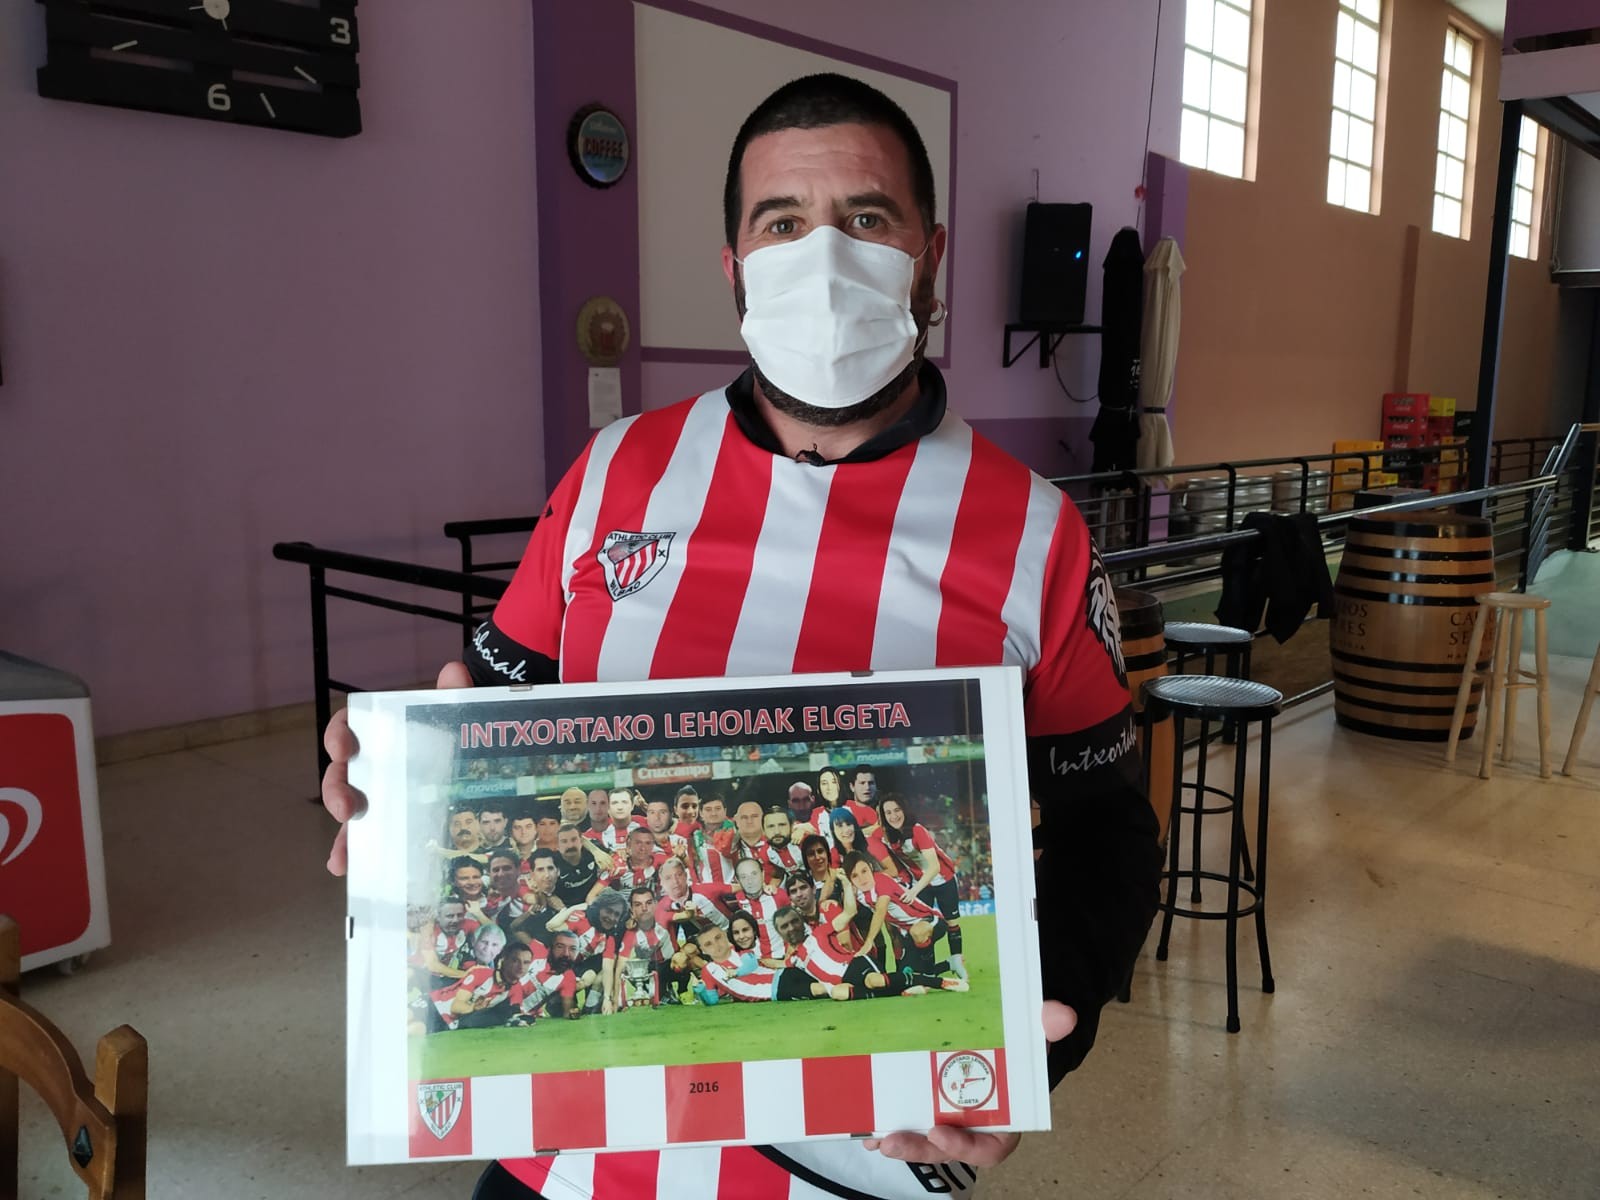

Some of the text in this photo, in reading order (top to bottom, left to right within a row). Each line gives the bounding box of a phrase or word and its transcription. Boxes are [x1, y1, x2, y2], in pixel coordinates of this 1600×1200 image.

[330, 17, 351, 45] 3
[207, 83, 231, 111] 6
[581, 136, 624, 158] COFFEE
[460, 702, 911, 749] INTXORTAKO LEHOIAK ELGETA
[856, 751, 905, 762] movistar
[638, 765, 711, 779] Cruzcampo
[689, 1081, 719, 1094] 2016
